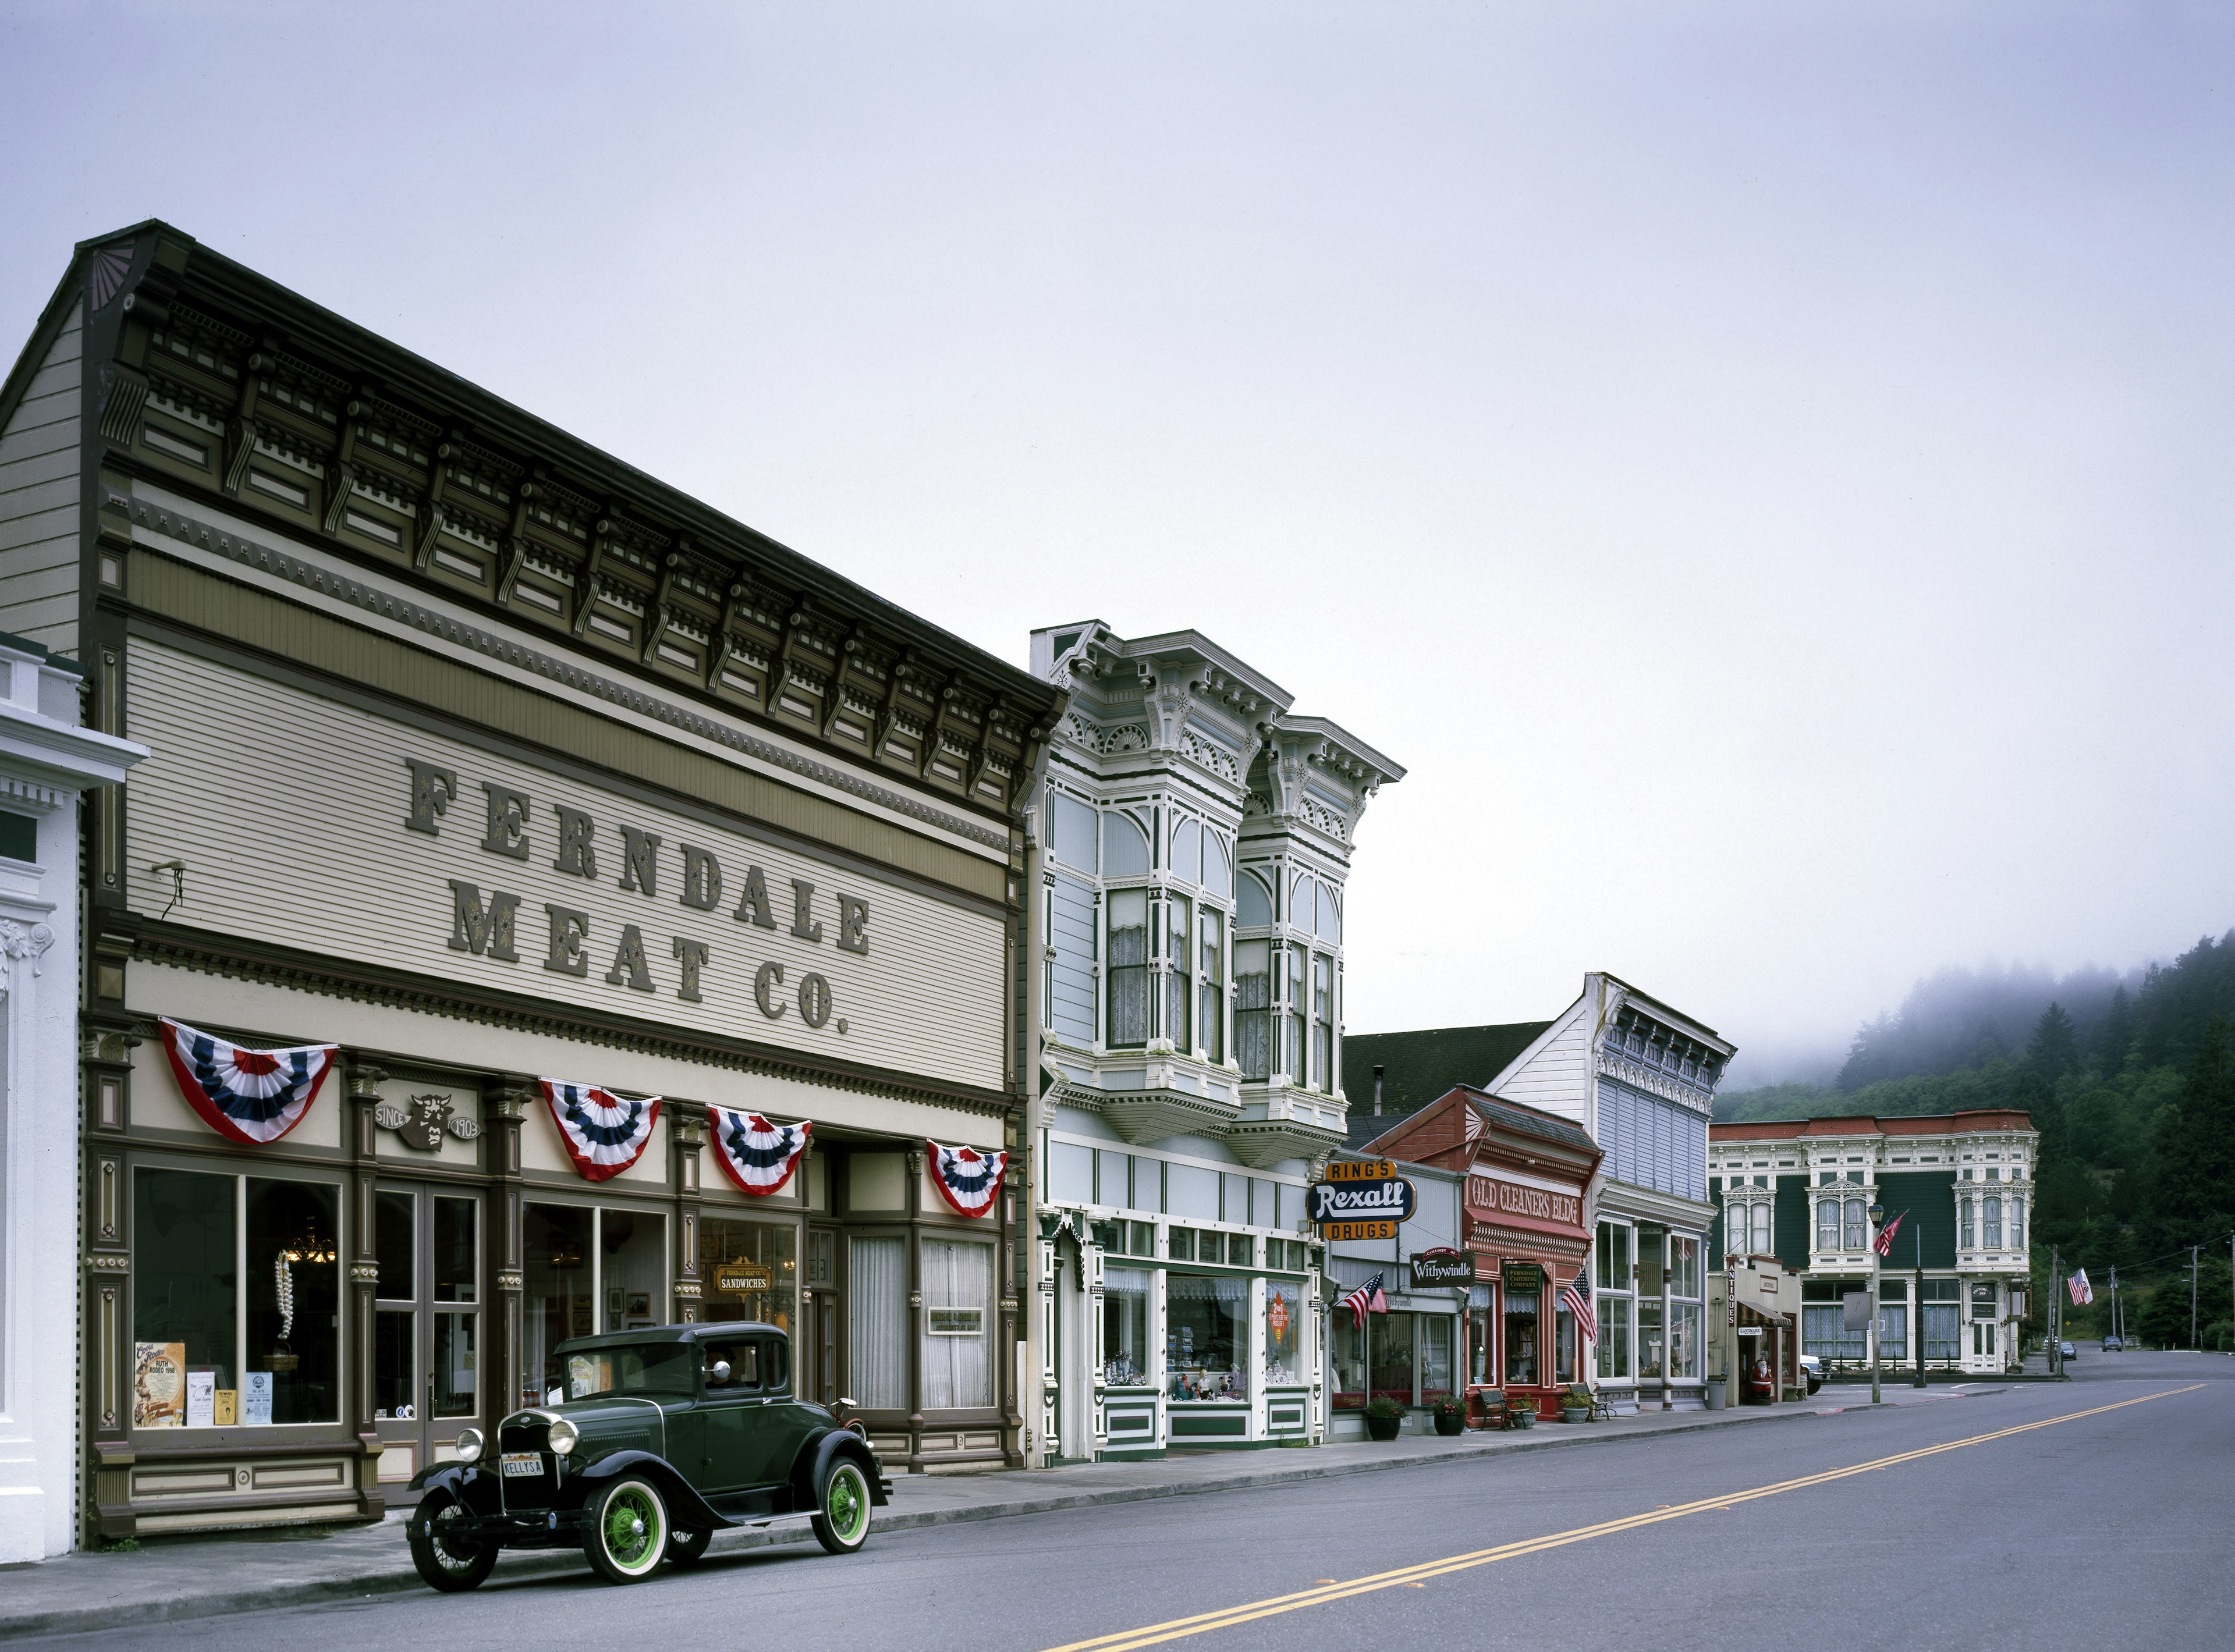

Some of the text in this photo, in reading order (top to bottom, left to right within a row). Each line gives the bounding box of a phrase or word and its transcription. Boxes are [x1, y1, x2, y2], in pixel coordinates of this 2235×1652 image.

[406, 757, 870, 955] FERNDALE
[448, 878, 849, 1035] MEAT CO.
[375, 1106, 478, 1137] SINCE 1903
[1332, 1163, 1389, 1178] RING'S
[1316, 1182, 1404, 1218] Rexall
[1472, 1177, 1577, 1224] OLD CLEANERS BLDG
[1332, 1223, 1388, 1239] DRUGS
[1413, 1260, 1471, 1280] Withywindle
[721, 1278, 767, 1288] SANDWICHES
[1273, 1302, 1277, 1314] 2
[1280, 1303, 1283, 1315] 1
[136, 1344, 154, 1359] Coors
[144, 1349, 165, 1363] Rodeo
[504, 1461, 542, 1473] KELLYS A
